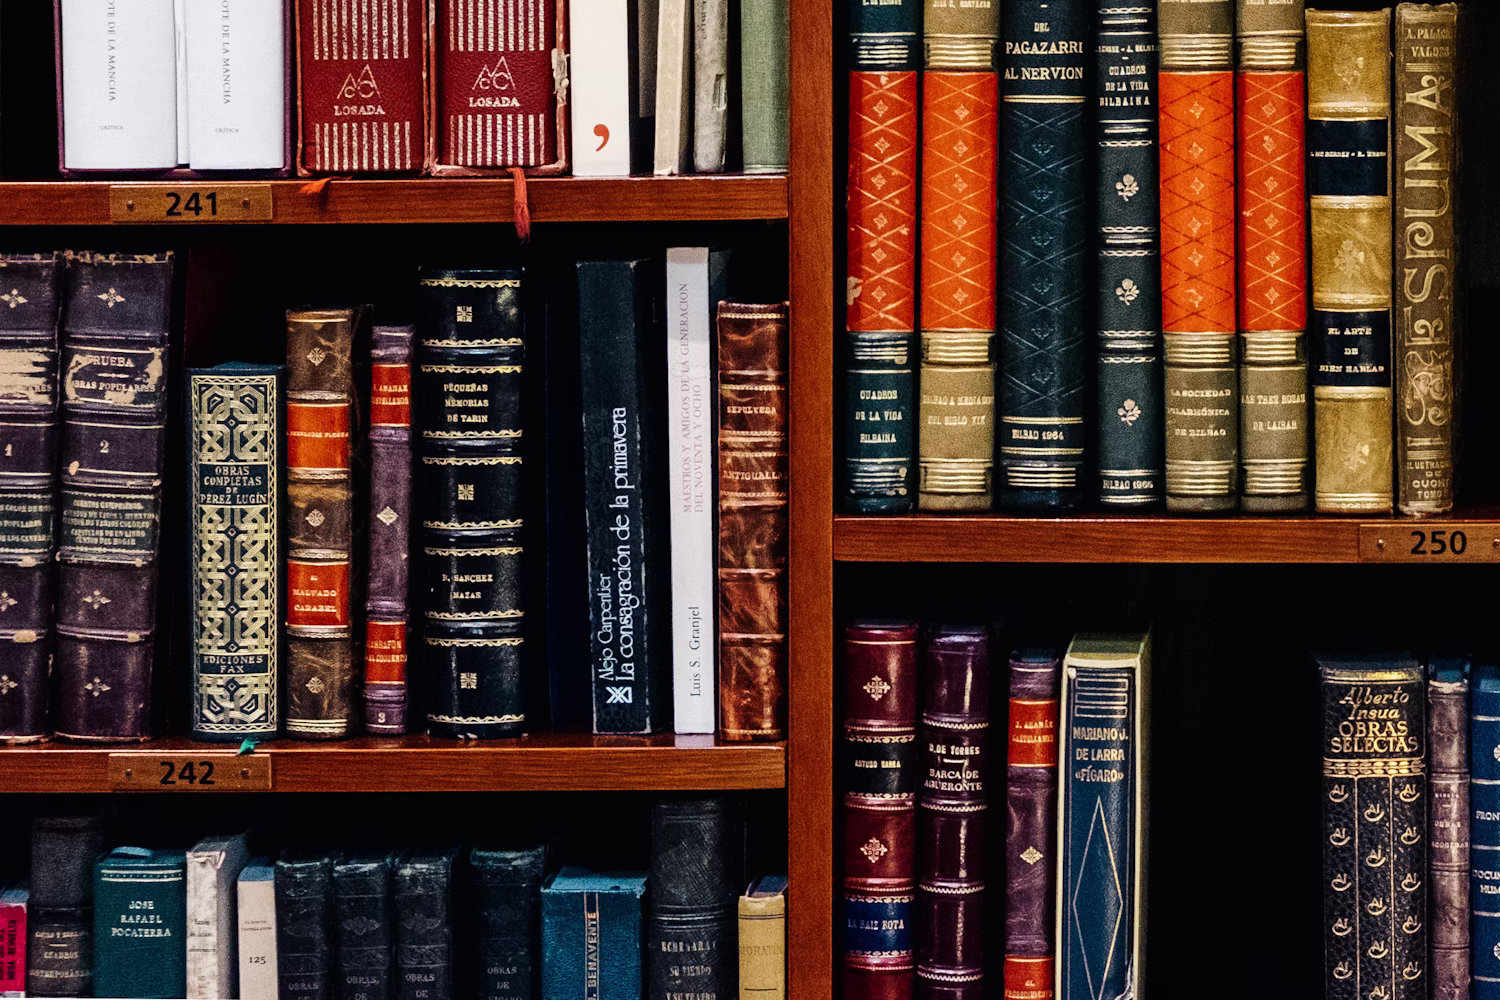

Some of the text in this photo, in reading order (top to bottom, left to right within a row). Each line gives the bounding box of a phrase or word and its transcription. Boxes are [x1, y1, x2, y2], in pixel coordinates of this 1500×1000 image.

[222, 25, 230, 38] DE
[1006, 41, 1083, 54] PAGAZARRI
[1004, 66, 1083, 80] AL NERVION
[223, 58, 231, 104] MANCHA
[469, 97, 520, 107] LOSADA
[334, 105, 385, 116] LOSADA
[165, 192, 218, 218] 241
[100, 440, 109, 453] 2
[215, 466, 250, 476] OBRAS
[204, 476, 262, 486] COMPLETAS
[200, 493, 233, 504] PÉREZ
[609, 407, 639, 681] La consagración de la primavera
[1411, 531, 1466, 555] 250
[597, 574, 617, 681] Alejo Carpentier
[689, 607, 702, 697] Luis S. Granjel
[203, 656, 263, 665] EDICIONES
[220, 665, 244, 673] FAX
[1339, 686, 1409, 704] Alberto
[1348, 706, 1400, 720] Insua
[1339, 721, 1408, 736] OBRAS
[1330, 737, 1418, 753] SELECTAS
[1076, 748, 1125, 761] DE LARRA
[160, 762, 215, 785] 242
[129, 900, 154, 910] JOSE
[120, 914, 162, 924] RAFAEL
[111, 928, 171, 937] POCATERRA
[587, 911, 597, 988] BENAVENTE
